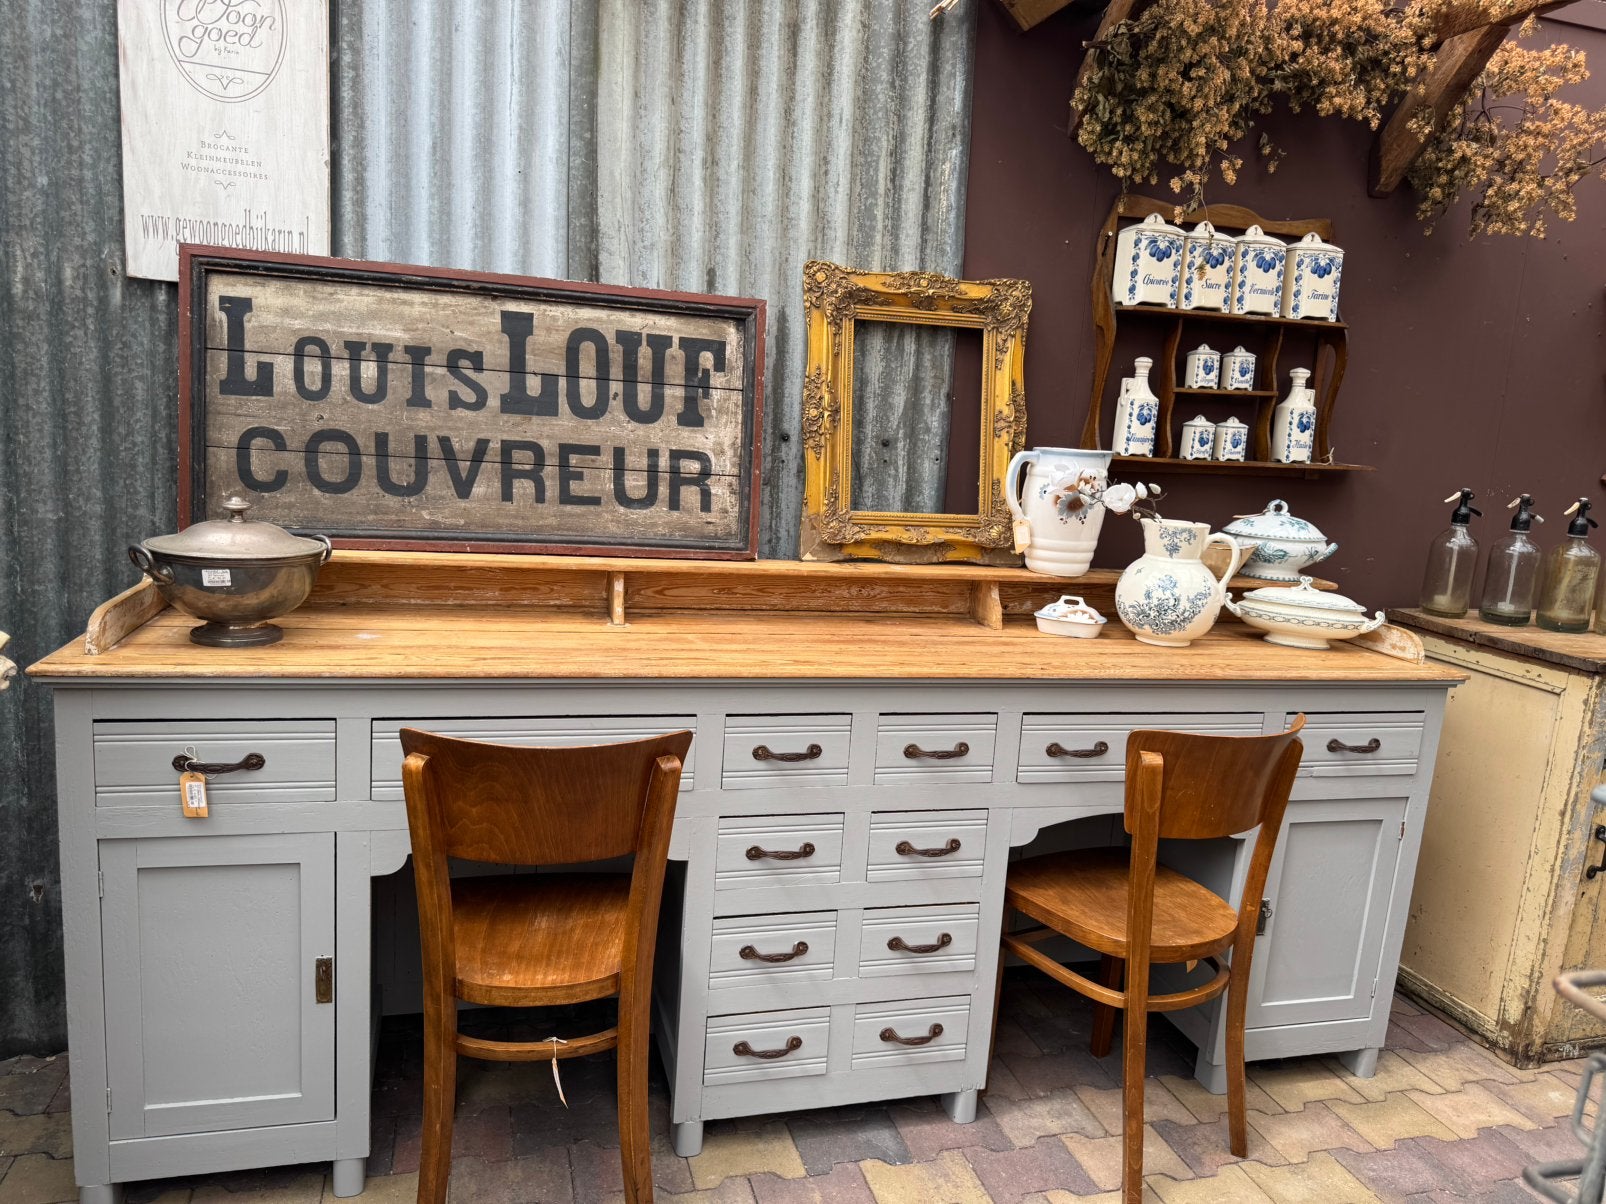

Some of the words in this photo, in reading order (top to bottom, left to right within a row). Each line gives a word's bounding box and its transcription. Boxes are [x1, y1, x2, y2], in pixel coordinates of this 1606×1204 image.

[178, 24, 263, 58] goed
[1201, 278, 1222, 291] Sucre
[500, 310, 727, 428] LOUF
[235, 425, 713, 513] COUVREUR
